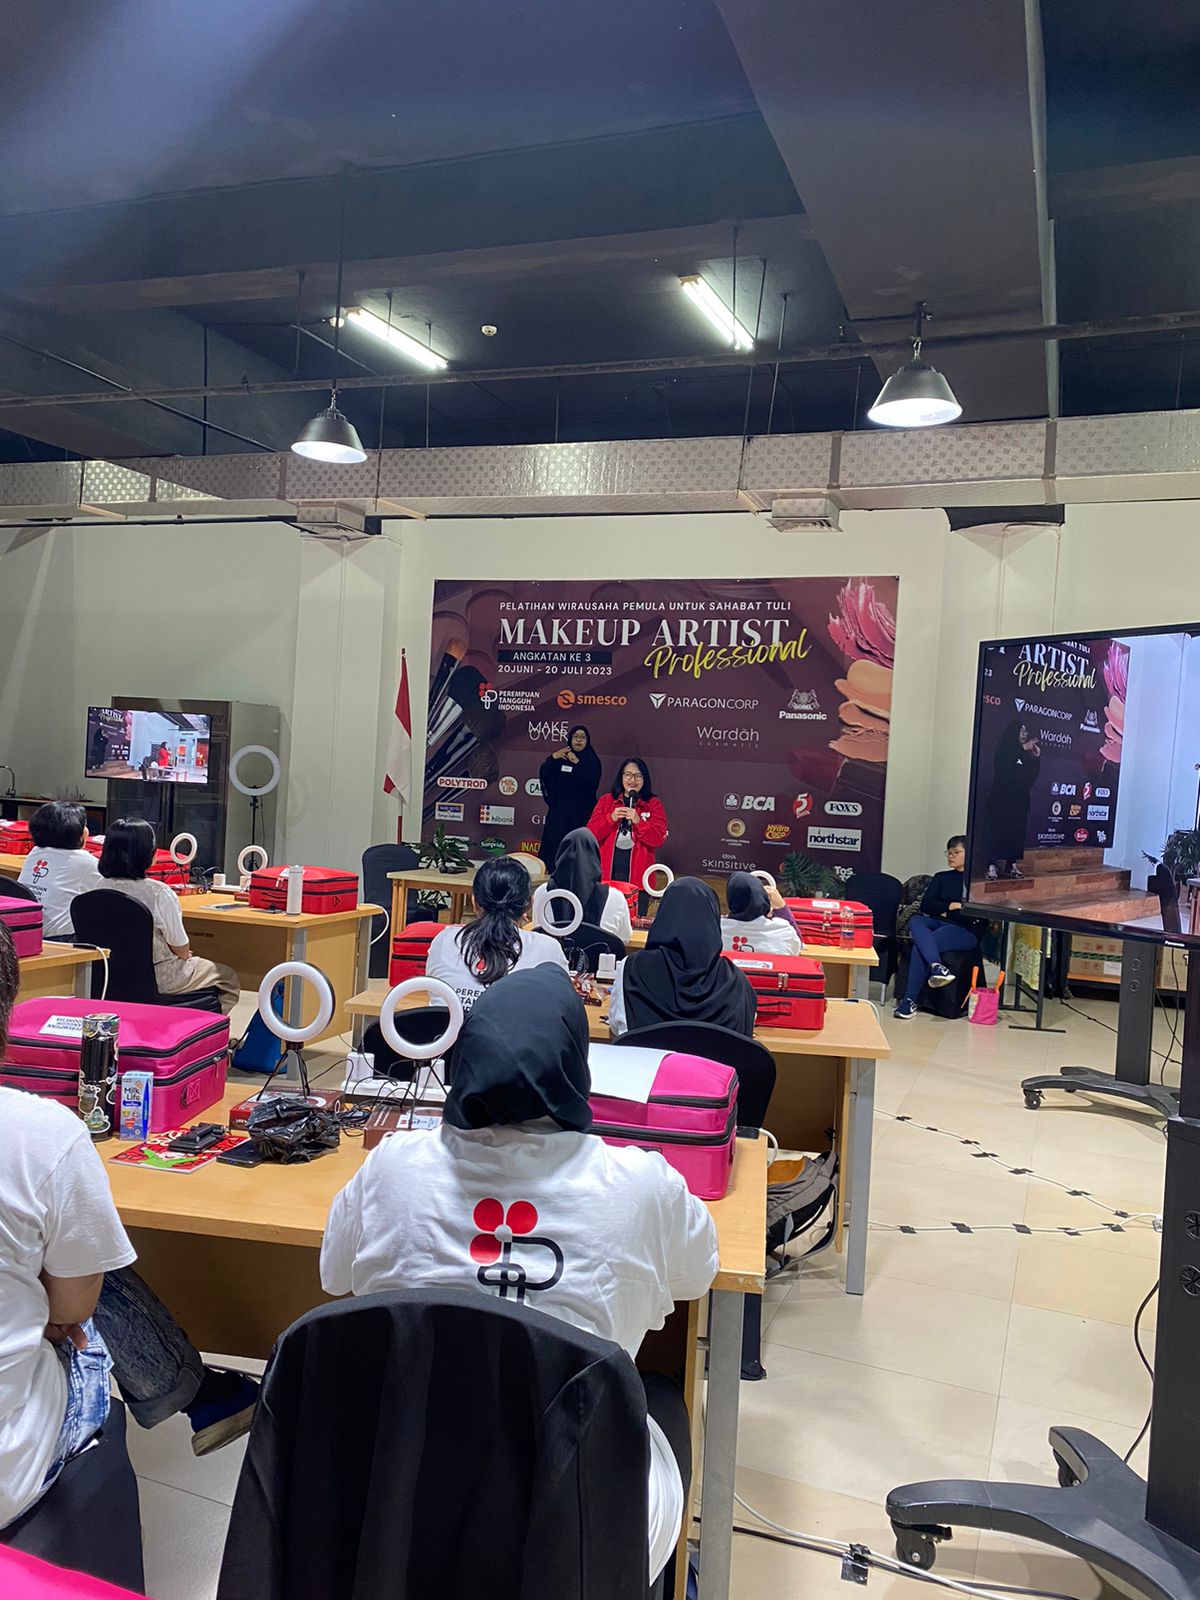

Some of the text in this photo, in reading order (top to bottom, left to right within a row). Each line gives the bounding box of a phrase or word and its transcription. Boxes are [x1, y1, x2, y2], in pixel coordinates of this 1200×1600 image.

[500, 601, 791, 611] PELATIHAN WIRAUSAHA PEMULA UNTUK SAHABAT TULI
[499, 618, 789, 647] MAKEUP ARTIST
[513, 652, 591, 662] ANGKATAN KE 3
[644, 628, 812, 679] Professional
[1018, 643, 1089, 677] ARTIST
[498, 665, 533, 674] 20JUNI
[545, 665, 558, 674] 20
[561, 666, 583, 675] JULI
[586, 666, 612, 675] 2023
[1013, 660, 1096, 692] Professional
[499, 690, 540, 698] PEREMPUAN
[577, 694, 627, 706] smesco
[498, 704, 535, 712] INDONESIA
[667, 696, 759, 710] PARAGONCORP
[779, 710, 828, 720] Panasonic
[529, 721, 569, 733] MAKE
[529, 728, 569, 742] OVER
[439, 778, 486, 789] POLYTRON
[1060, 784, 1076, 796] BCA
[741, 796, 775, 811] BCA
[796, 792, 808, 813] 5
[767, 824, 790, 833] Hydro
[766, 831, 786, 840] Coco
[809, 833, 859, 846] northstar
[521, 841, 541, 853] INAC
[456, 987, 480, 998] PERE
[126, 1093, 141, 1101] Life
